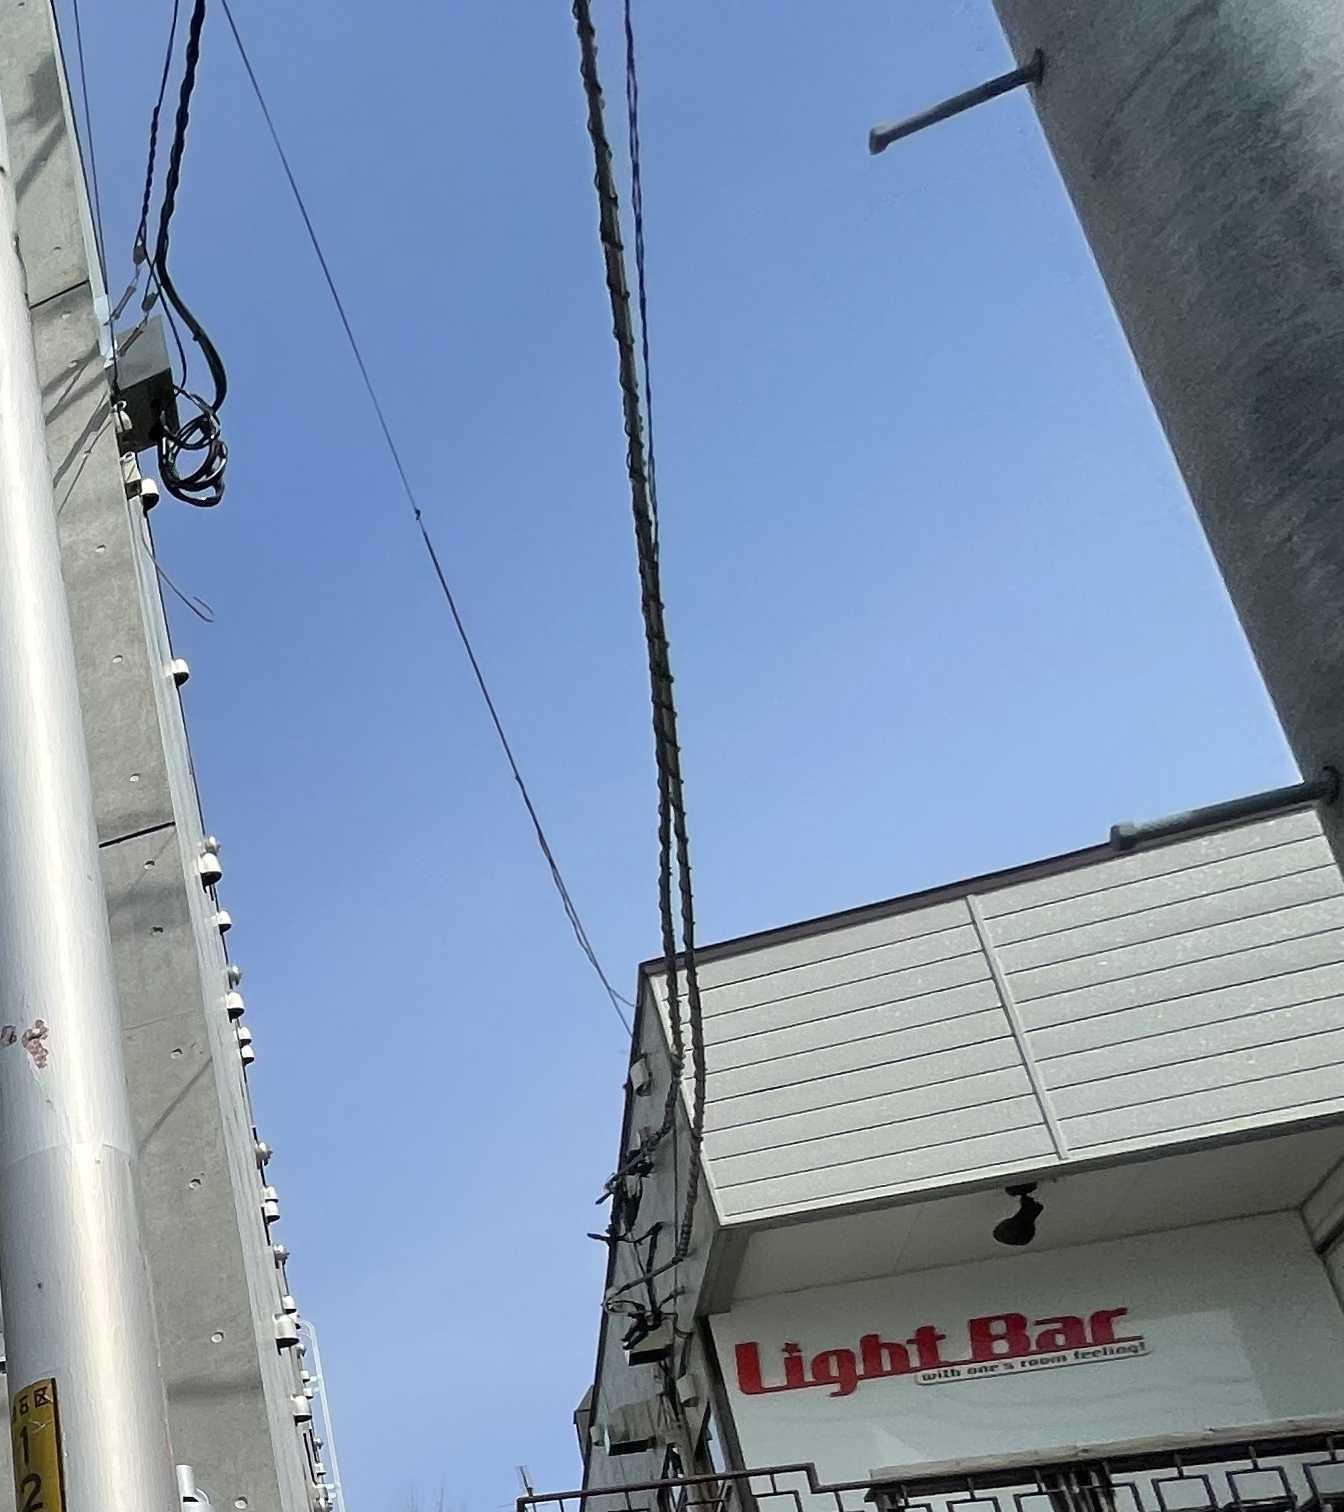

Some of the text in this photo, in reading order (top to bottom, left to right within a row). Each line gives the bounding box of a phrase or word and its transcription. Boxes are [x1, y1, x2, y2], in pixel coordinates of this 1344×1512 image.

[734, 1307, 1143, 1398] Light Bar
[921, 1367, 961, 1382] with
[1020, 1354, 1068, 1369] room
[1074, 1341, 1147, 1361] feeling!
